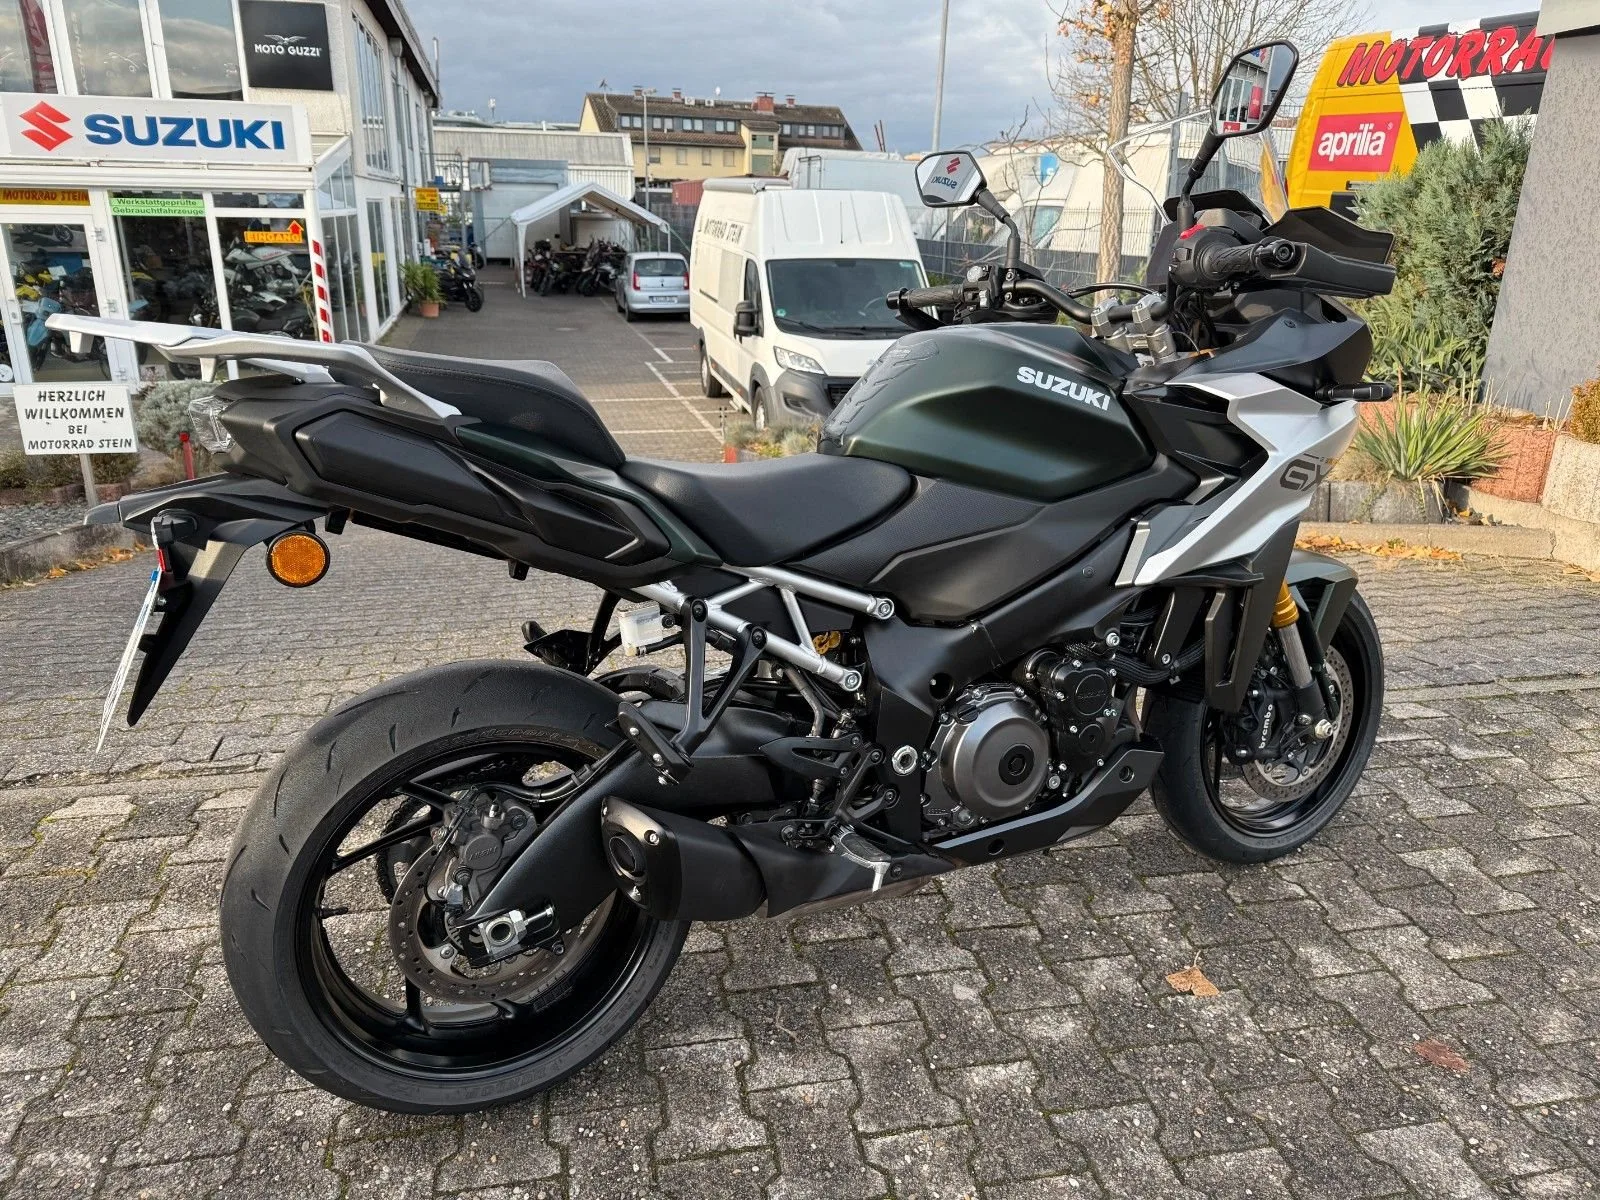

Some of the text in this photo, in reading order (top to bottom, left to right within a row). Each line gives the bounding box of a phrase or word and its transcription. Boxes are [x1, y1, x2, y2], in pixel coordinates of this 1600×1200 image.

[254, 44, 321, 57] MOTO GUZZI
[1337, 24, 1556, 87] MOTORRA
[84, 113, 286, 150] SUZUKI
[1318, 123, 1386, 162] aprilia
[3, 190, 88, 201] MOTORRAD STEIN
[117, 198, 197, 206] Werkstattgeprüfte
[113, 207, 204, 215] Gebrauchtfahrzeuge
[1017, 366, 1111, 411] SUZUKI
[37, 390, 106, 402] HERZLICH
[25, 407, 124, 419] WILLKOMMEN
[68, 425, 87, 434] BEI
[28, 438, 132, 450] MOTORRAD STEIN
[1259, 703, 1274, 749] brembo
